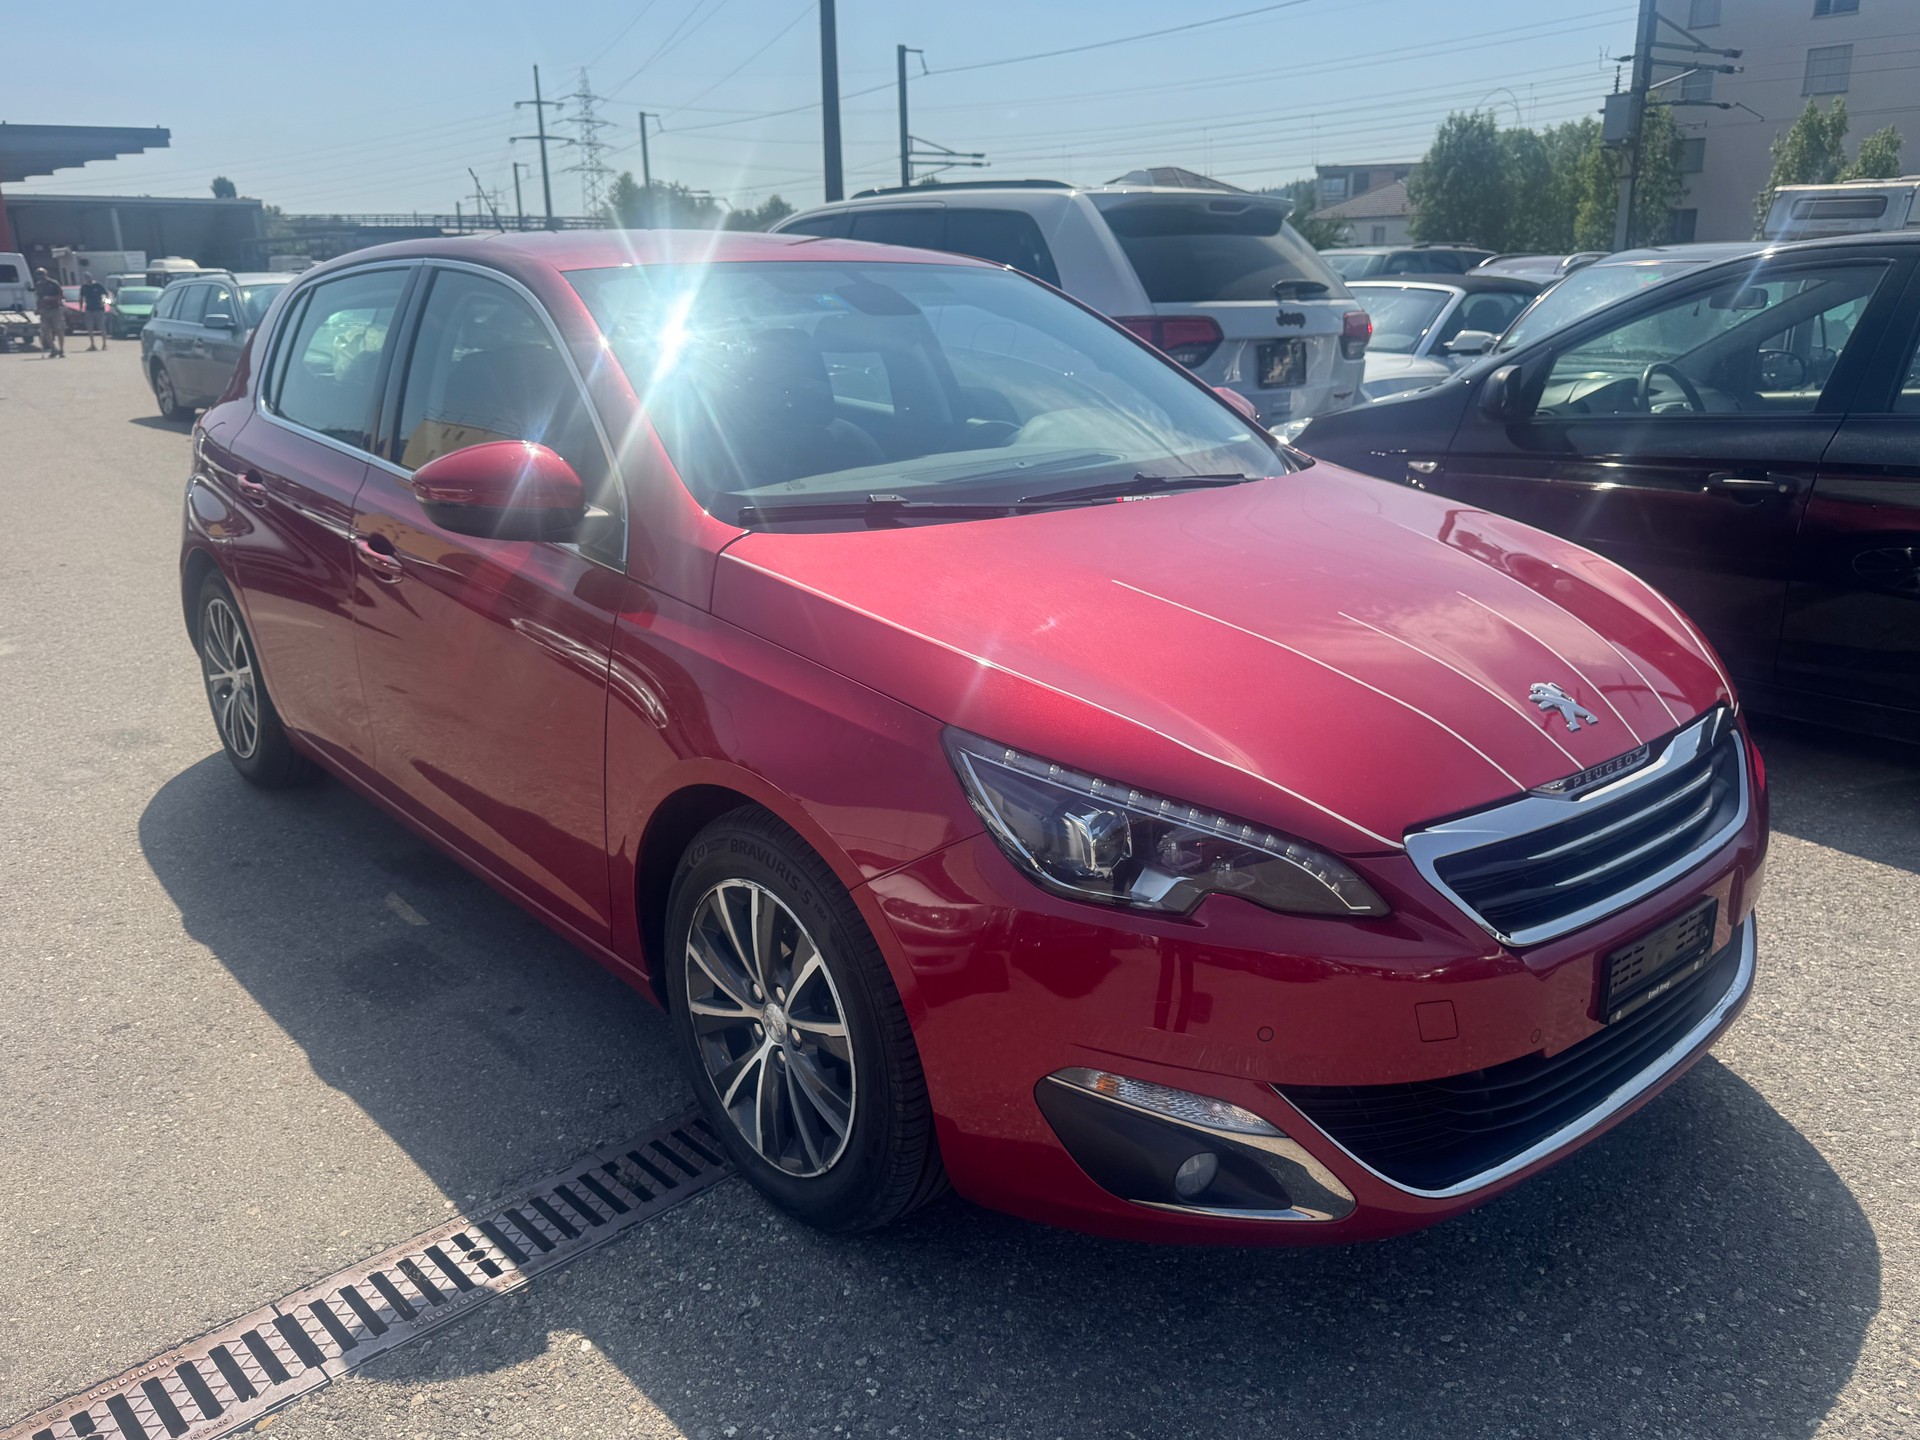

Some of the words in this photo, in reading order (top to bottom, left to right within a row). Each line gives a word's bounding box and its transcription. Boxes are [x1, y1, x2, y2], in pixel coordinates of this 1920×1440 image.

[1573, 750, 1641, 788] PEUGEOT
[730, 838, 801, 892] BRAVURIS
[424, 1287, 493, 1323] hauraton
[88, 1357, 169, 1401] hauraton
